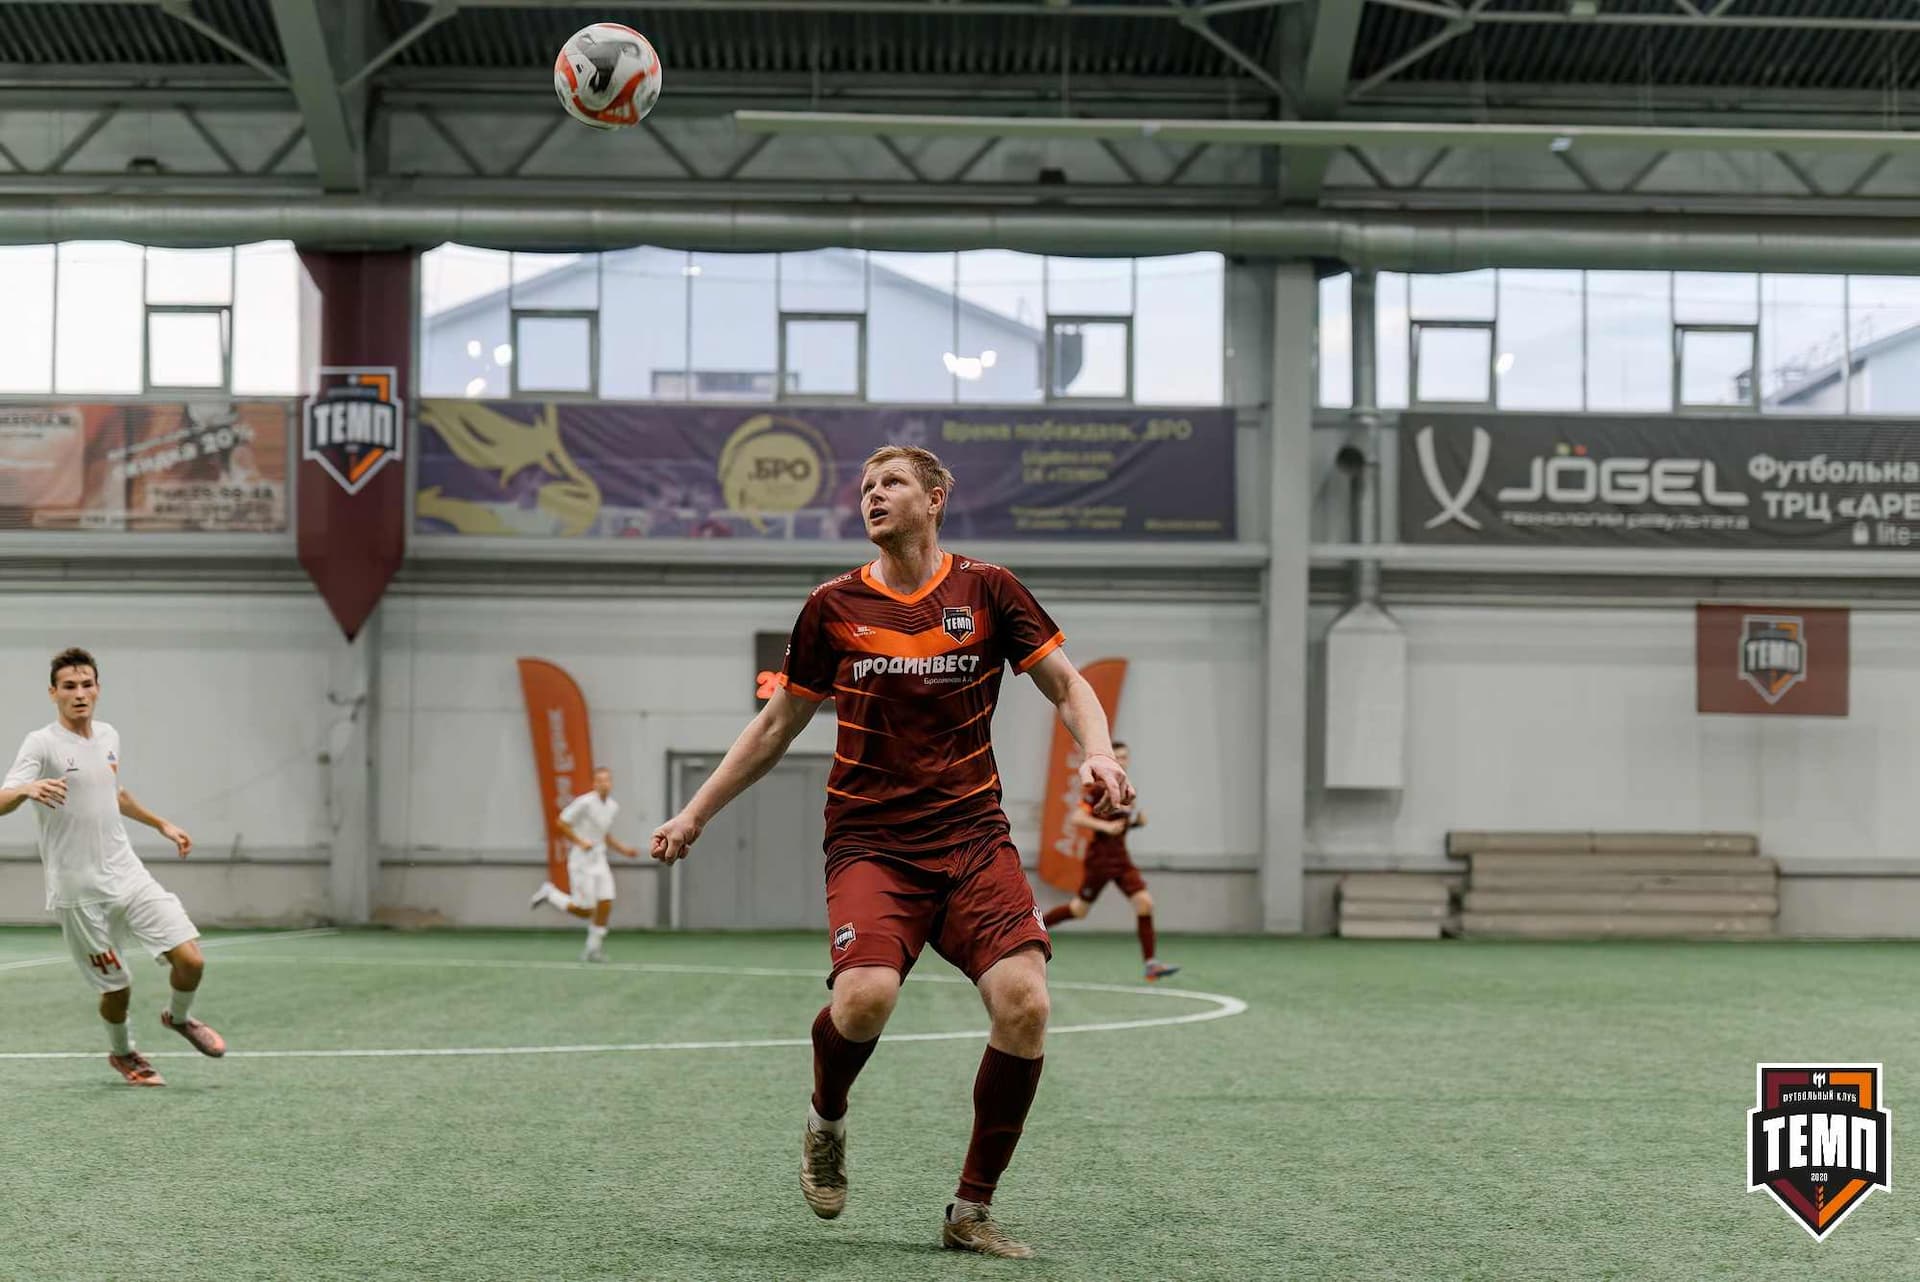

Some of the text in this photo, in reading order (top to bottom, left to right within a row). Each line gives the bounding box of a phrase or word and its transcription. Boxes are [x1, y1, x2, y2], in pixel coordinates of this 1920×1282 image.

[313, 402, 394, 446] ТЕМП
[1762, 491, 1832, 523] ТРЦ
[946, 616, 972, 631] ТЕМП
[853, 655, 979, 682] ПРОДИНВЕСТ
[89, 949, 121, 974] 44
